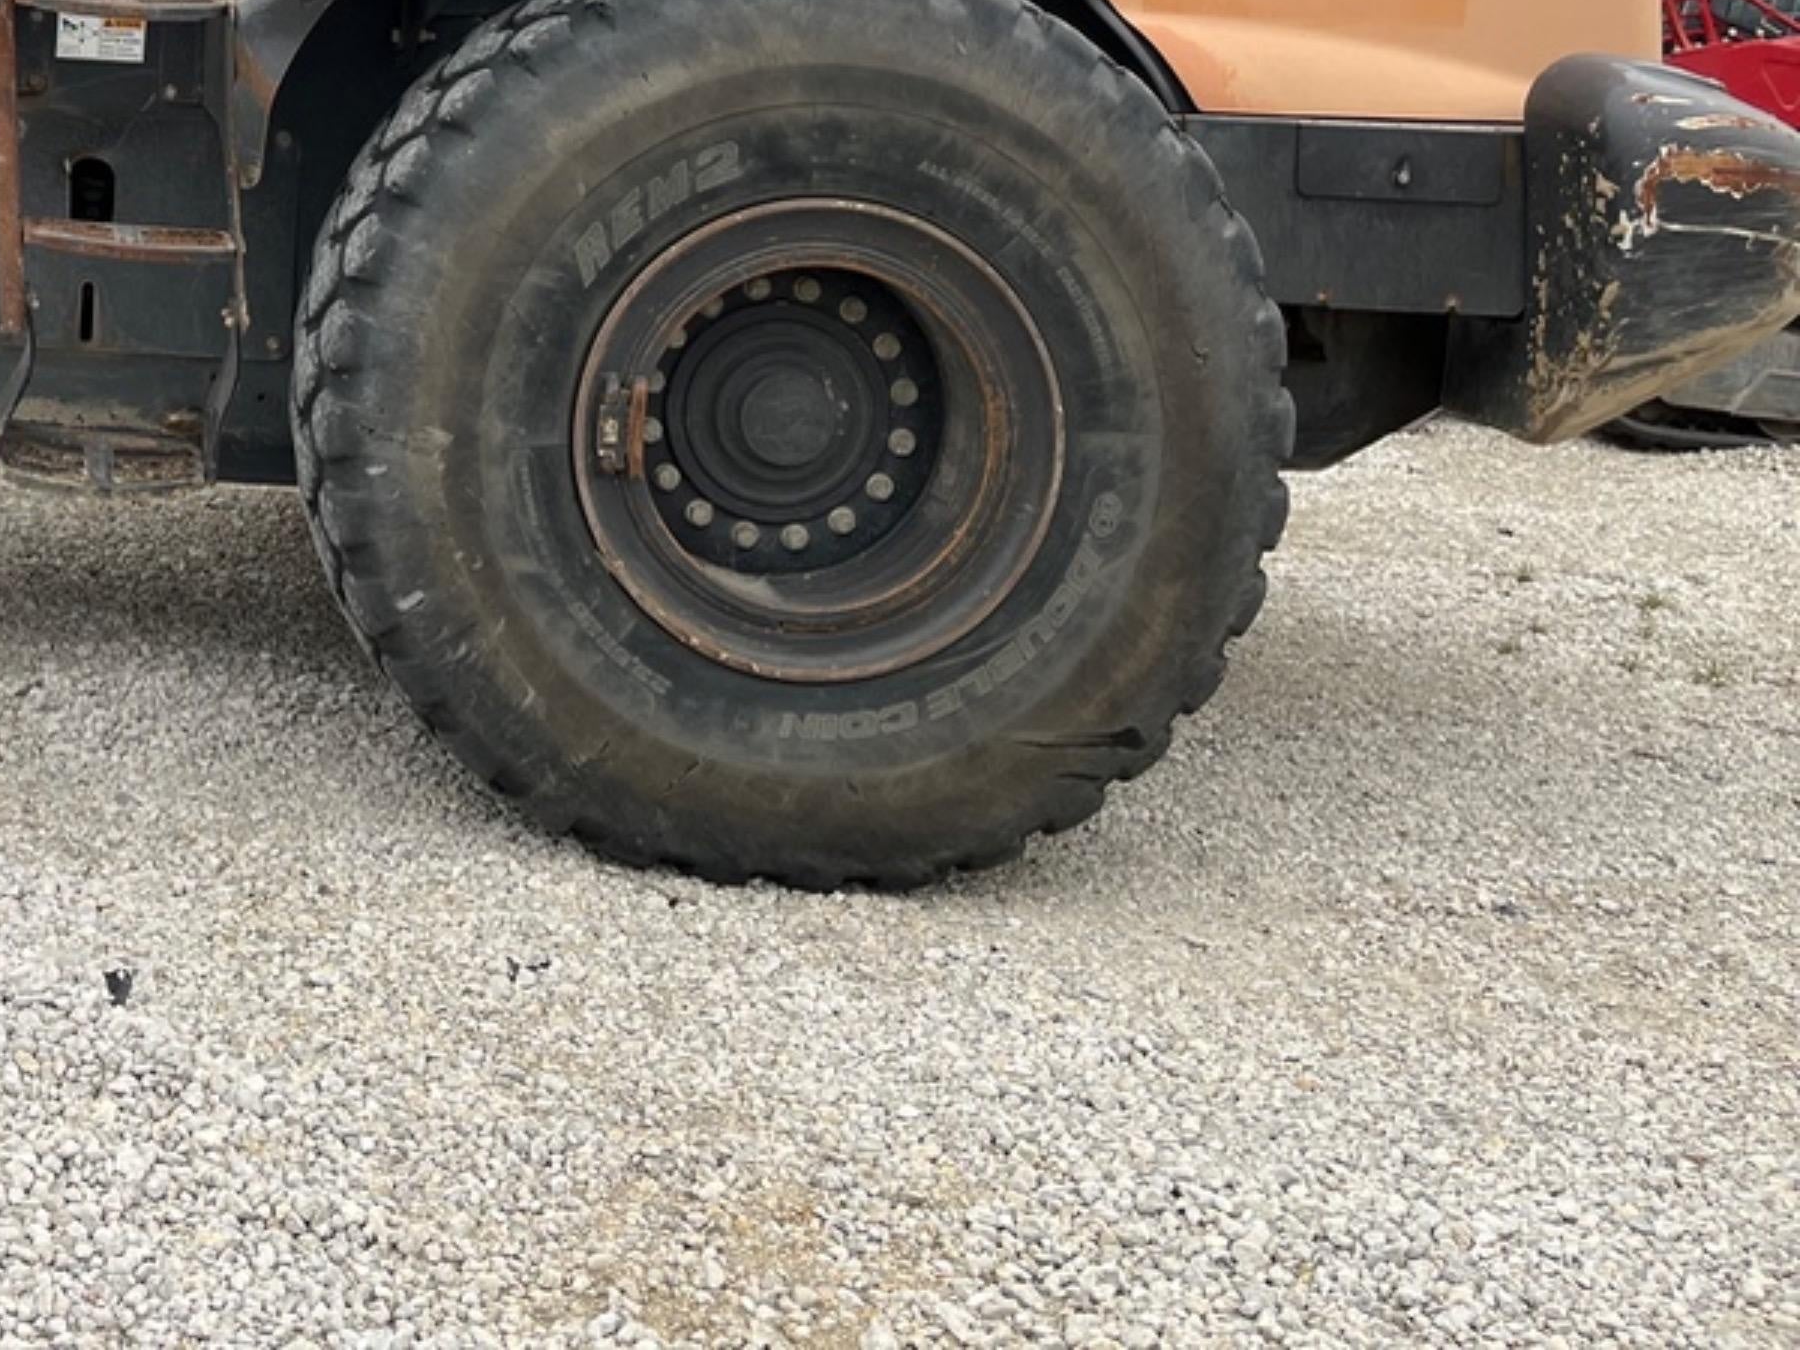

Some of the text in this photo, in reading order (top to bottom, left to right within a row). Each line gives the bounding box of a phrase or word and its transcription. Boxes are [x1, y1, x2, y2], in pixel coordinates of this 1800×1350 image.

[574, 140, 746, 289] REM2
[777, 534, 1101, 740] DOUBLE COIN
